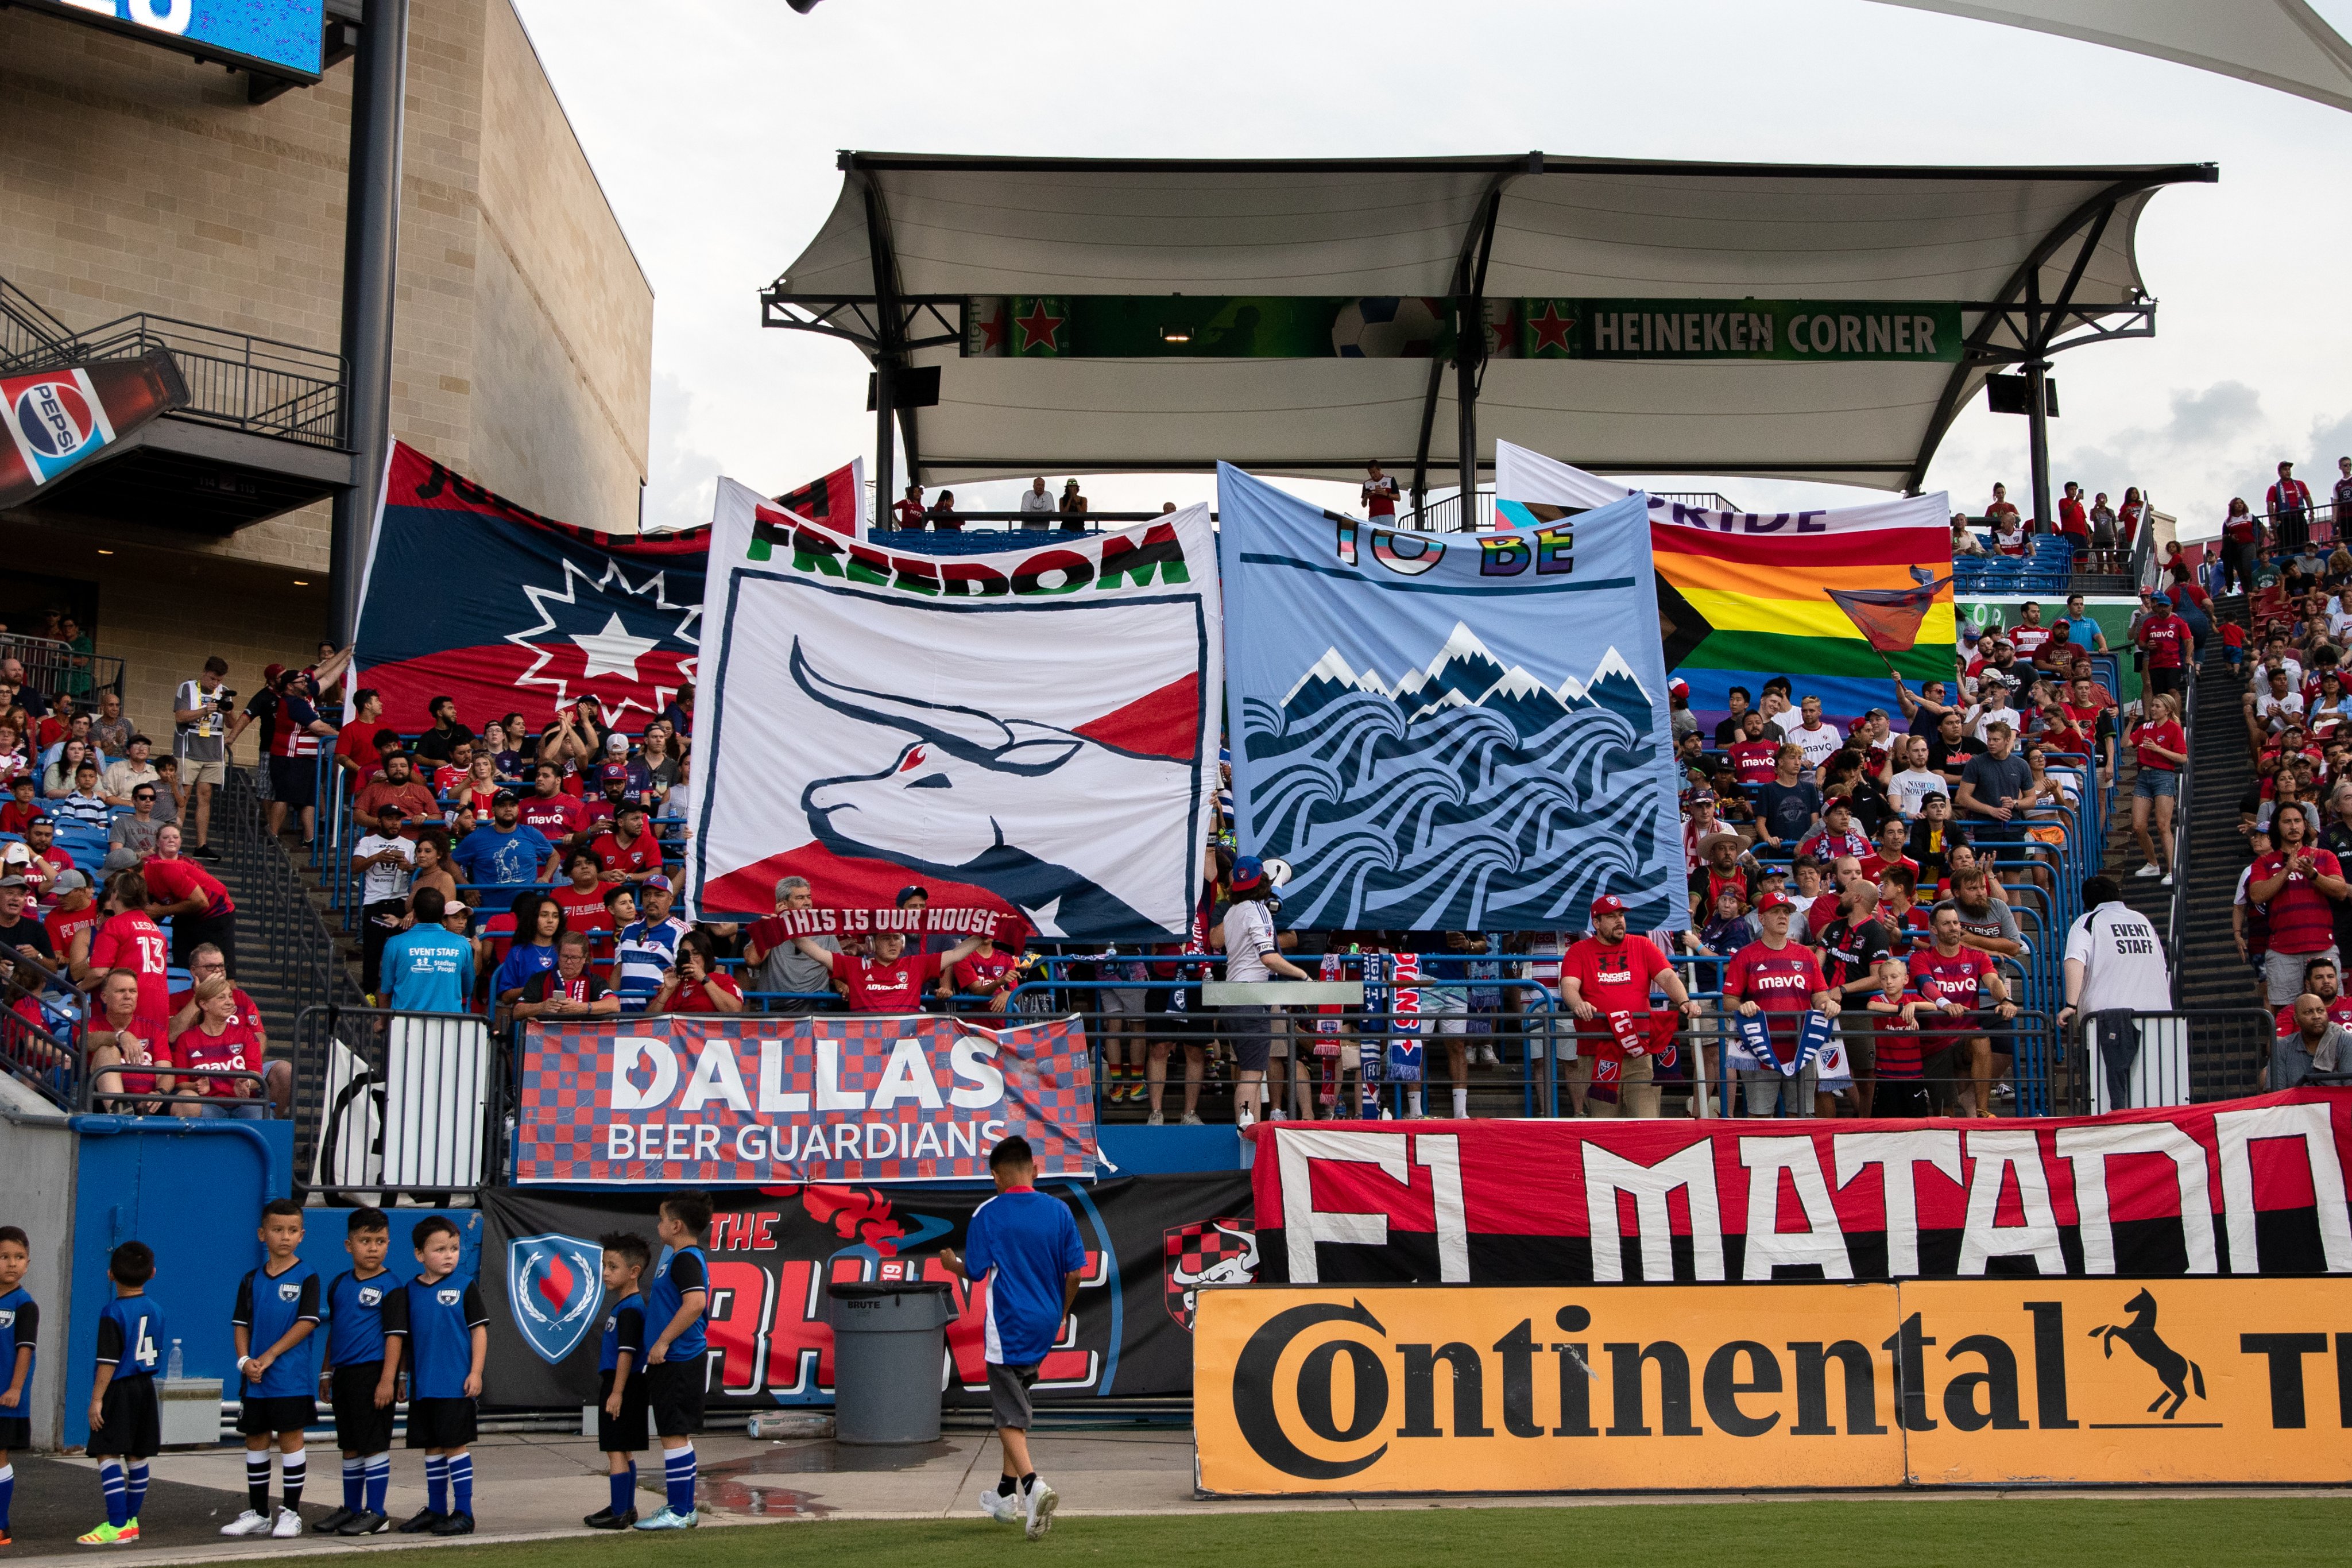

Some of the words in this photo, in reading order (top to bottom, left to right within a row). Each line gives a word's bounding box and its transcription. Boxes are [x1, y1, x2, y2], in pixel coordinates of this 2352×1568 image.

[1595, 313, 1774, 352] HEINEKEN
[1788, 315, 1937, 354] CORNER
[34, 385, 77, 455] PEPSI
[746, 503, 1192, 597] FREEDOM
[1324, 509, 1446, 576] TO
[1477, 522, 1575, 576] BE
[2149, 630, 2174, 638] mavQ
[1742, 757, 1775, 768] mavQ
[527, 814, 563, 824] mavQ
[779, 909, 837, 936] THIS
[842, 909, 869, 930] IS
[876, 909, 920, 930] OUR
[927, 908, 1000, 936] HOUSE
[2111, 924, 2149, 938] EVENT
[137, 936, 165, 974] 13
[409, 948, 435, 957] EVENT
[436, 948, 459, 957] STAFF
[2117, 939, 2153, 954] STAFF
[1758, 974, 1806, 990] mavQ
[1936, 977, 1976, 993] mavQ
[610, 1036, 1005, 1112] DALLAS
[1600, 1061, 1611, 1069] MLS
[607, 1123, 720, 1160] BEER
[735, 1120, 1007, 1162] GUARDIANS
[709, 1211, 780, 1250] THE
[848, 1300, 881, 1308] BRUTE
[135, 1315, 158, 1366] 4
[1232, 1296, 2080, 1480] Continental
